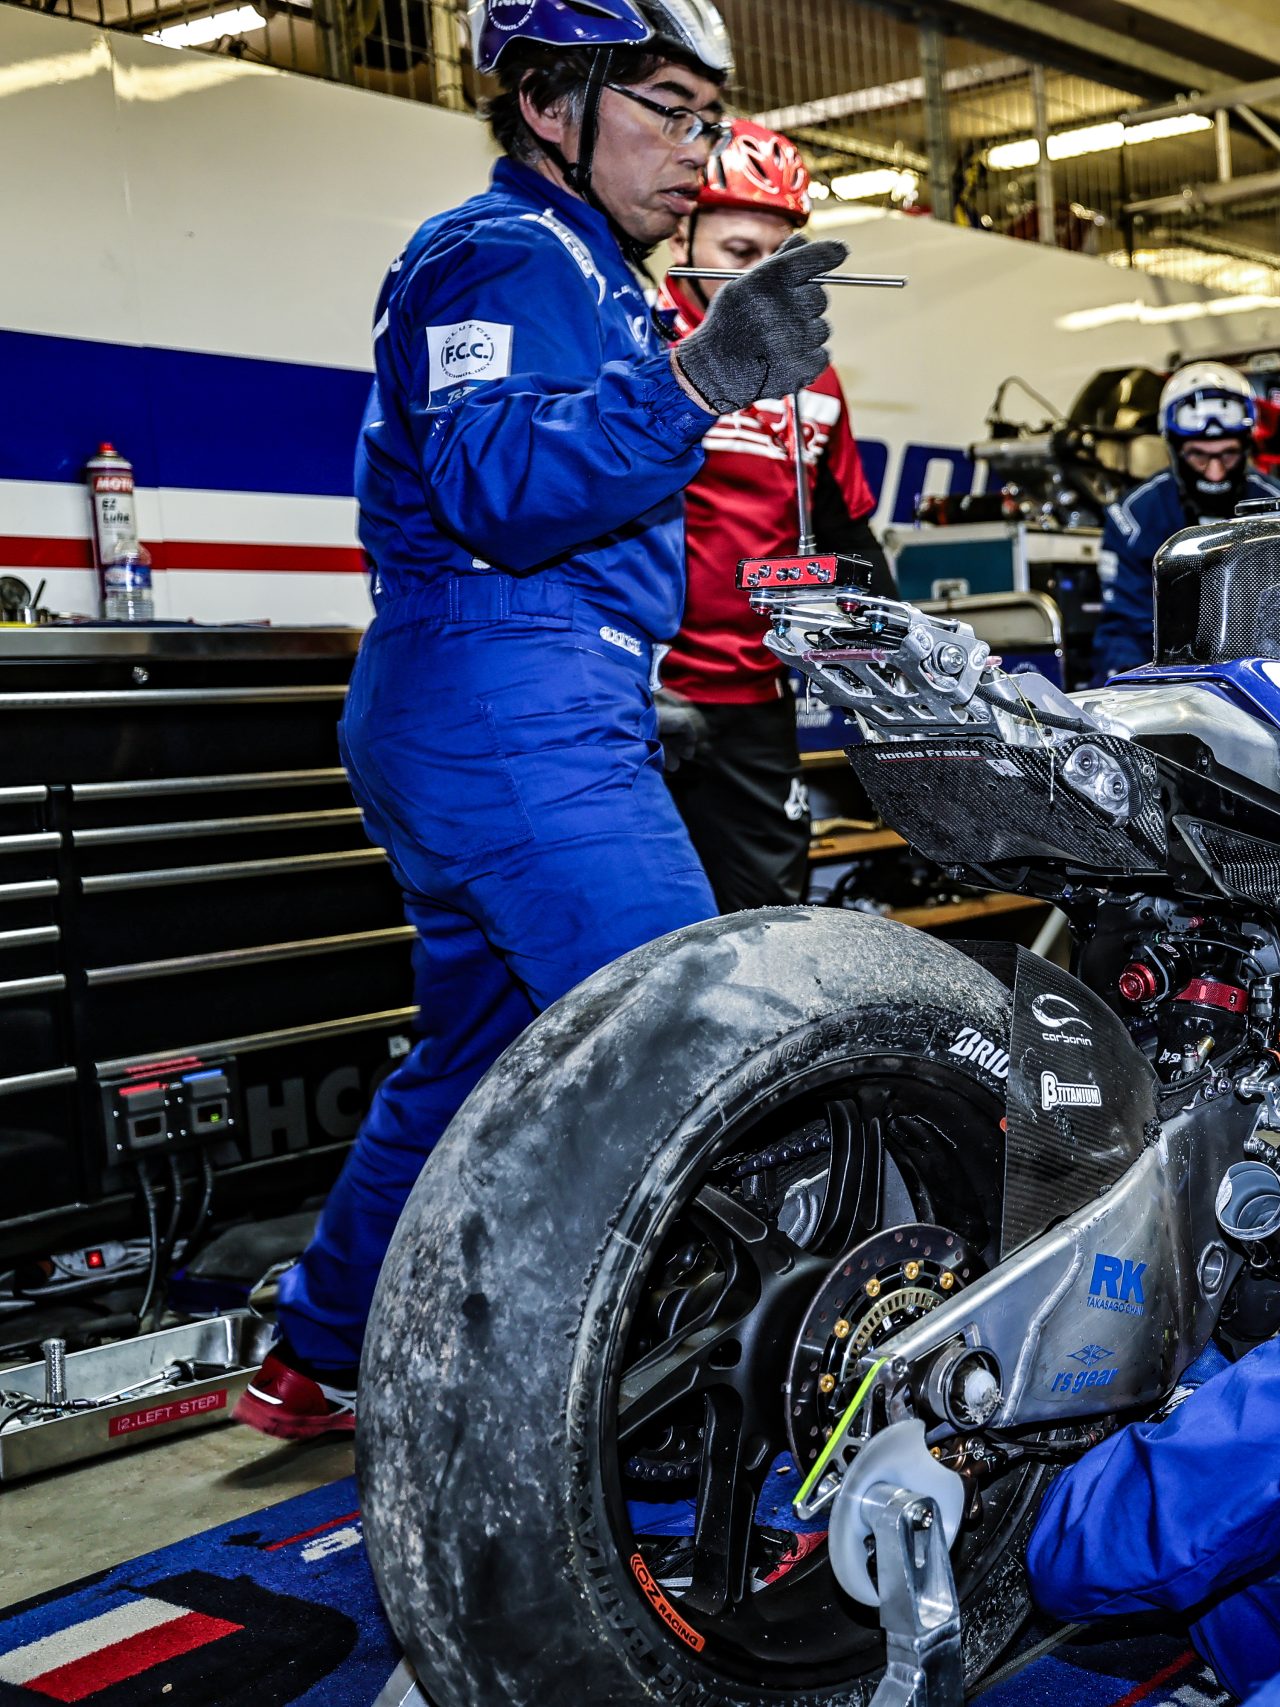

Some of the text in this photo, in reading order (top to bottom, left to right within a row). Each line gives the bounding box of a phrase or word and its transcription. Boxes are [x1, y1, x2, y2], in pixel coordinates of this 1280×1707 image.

[445, 324, 492, 344] CLUTCH
[445, 342, 489, 365] F.C.C.
[875, 749, 981, 761] Honda France
[1041, 1031, 1093, 1047] carbonin
[1089, 1253, 1147, 1304] RK
[1071, 1367, 1119, 1394] gear
[658, 1604, 699, 1647] RACING
